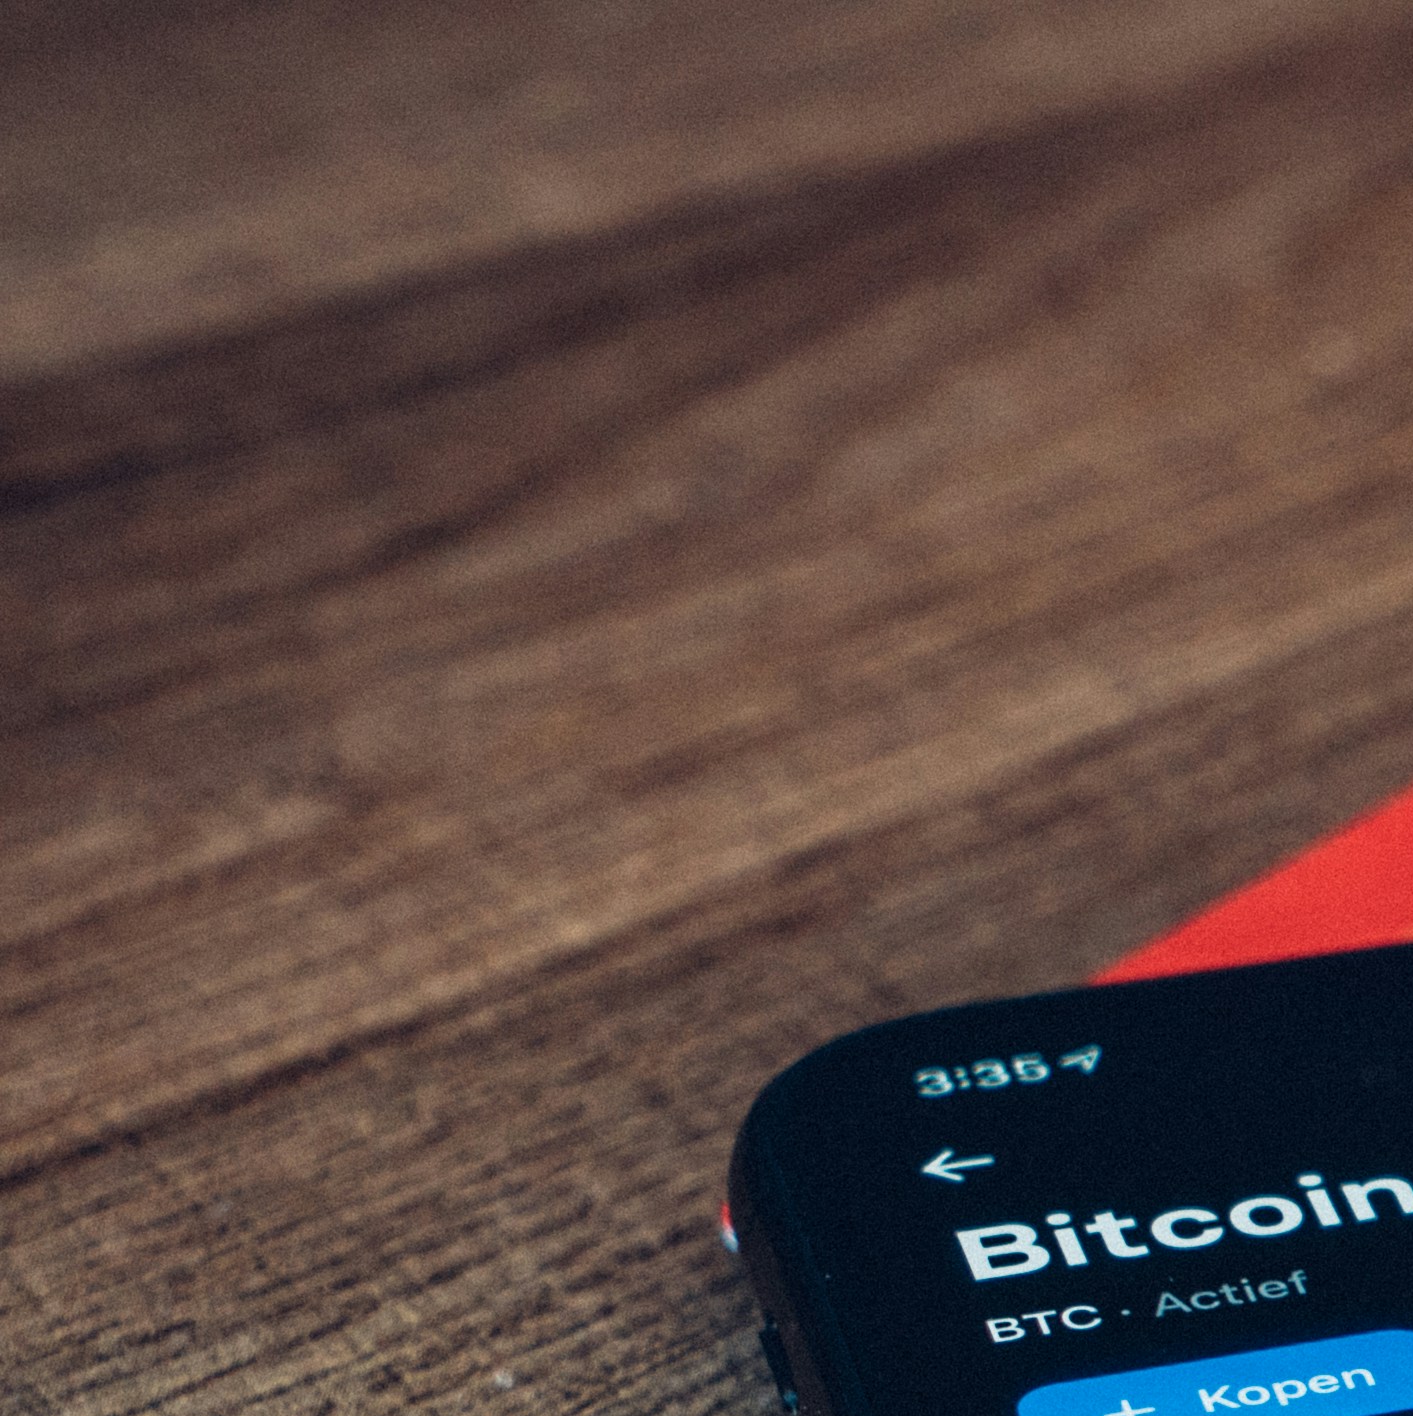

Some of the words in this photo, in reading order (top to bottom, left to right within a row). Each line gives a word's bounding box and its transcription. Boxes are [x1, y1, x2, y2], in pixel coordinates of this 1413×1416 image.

[915, 1053, 1051, 1098] 3:35
[985, 1304, 1103, 1344] BTC
[1154, 1269, 1308, 1319] Actief
[1197, 1363, 1378, 1414] Kopen
